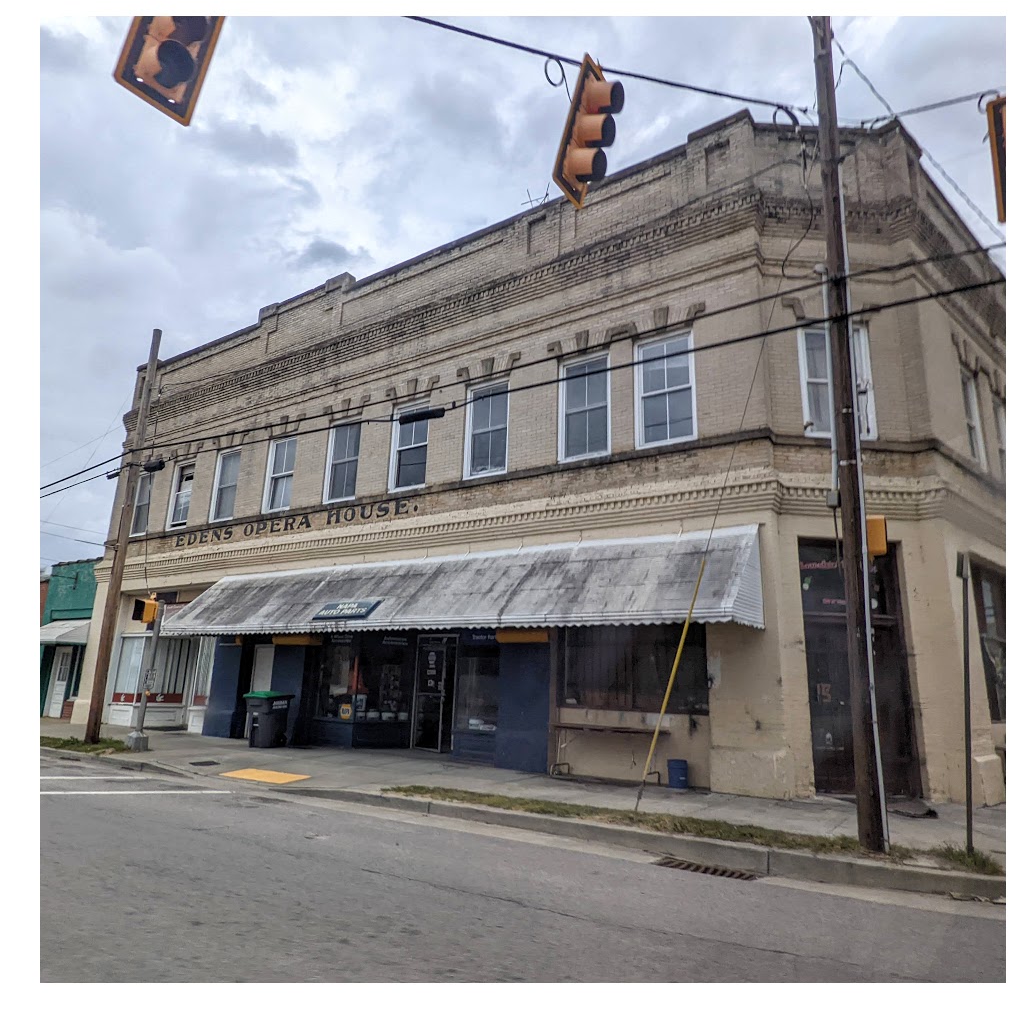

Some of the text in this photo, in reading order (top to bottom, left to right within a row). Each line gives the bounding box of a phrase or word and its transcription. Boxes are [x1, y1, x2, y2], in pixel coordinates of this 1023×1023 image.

[175, 498, 419, 548] EDENS OPERA HOUSE.
[336, 602, 359, 610] NAPA
[340, 607, 368, 615] PARTS
